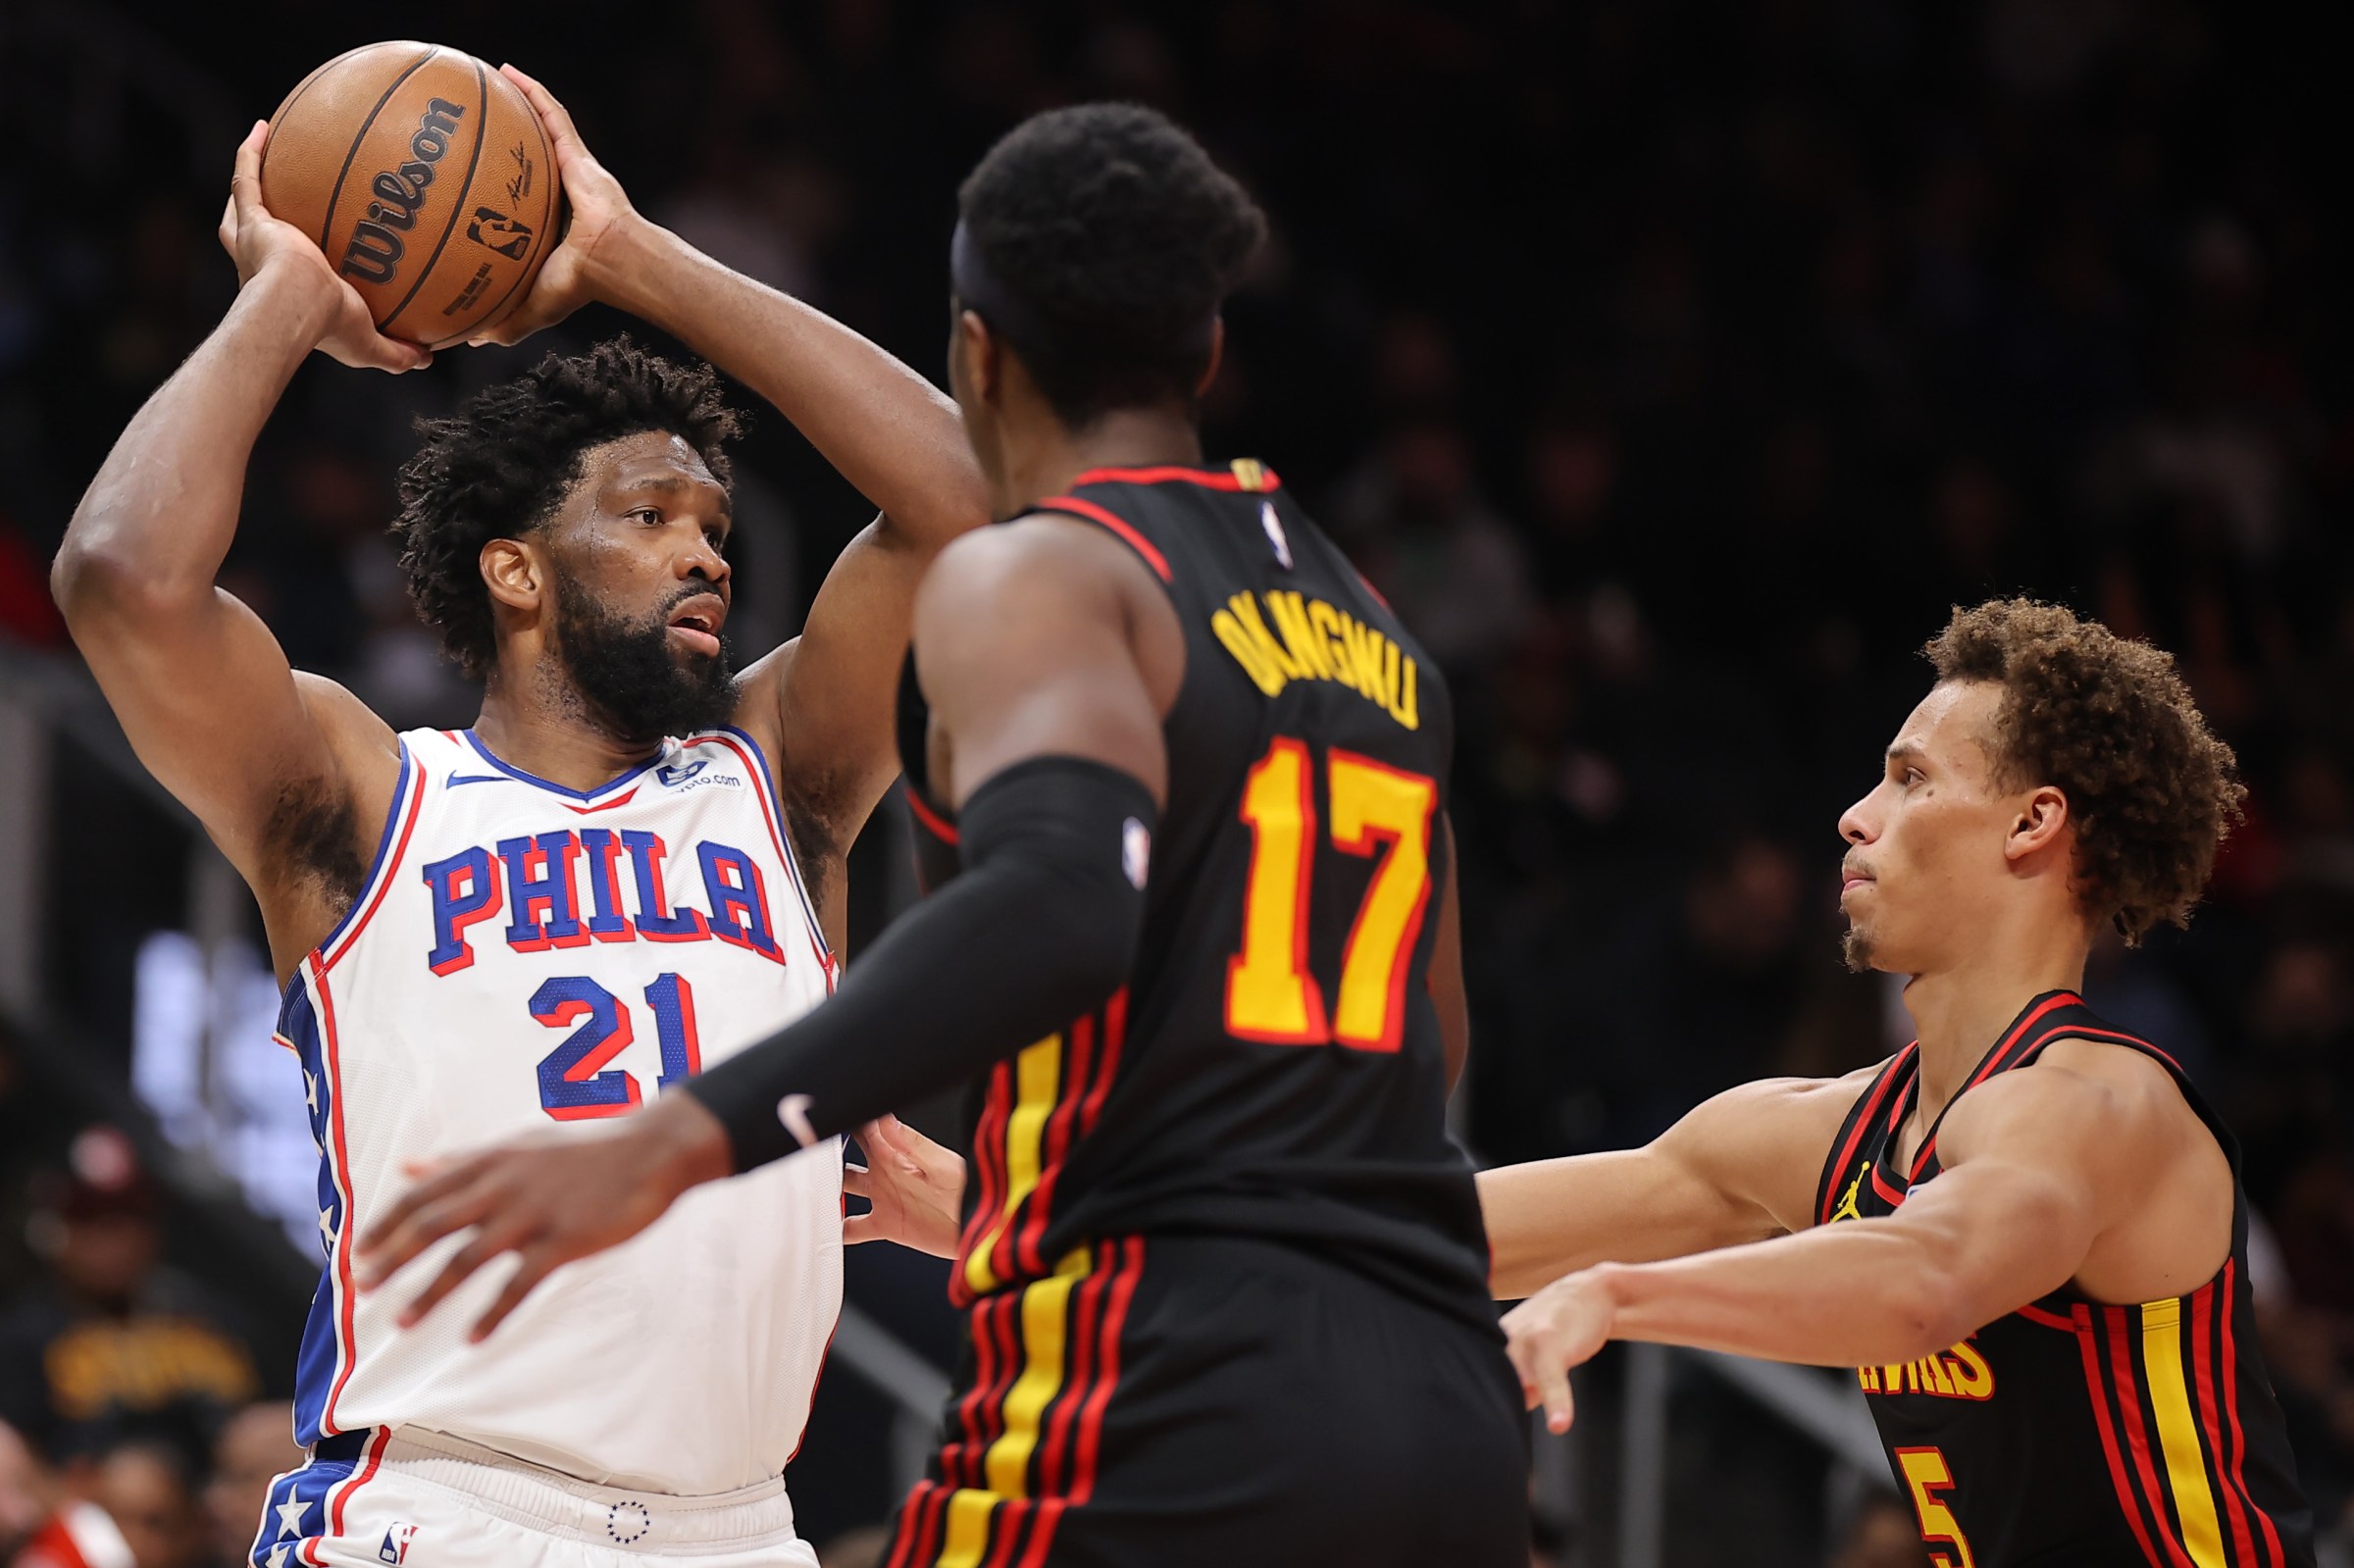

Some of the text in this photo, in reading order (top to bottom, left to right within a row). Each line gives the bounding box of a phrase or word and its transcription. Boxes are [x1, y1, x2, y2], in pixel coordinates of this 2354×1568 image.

[340, 97, 466, 284] Wilson
[422, 829, 786, 978] PHILA
[1224, 734, 1438, 1052] 17
[528, 972, 701, 1121] 21
[381, 1547, 396, 1562] NBA
[1894, 1445, 1976, 1568] 5
